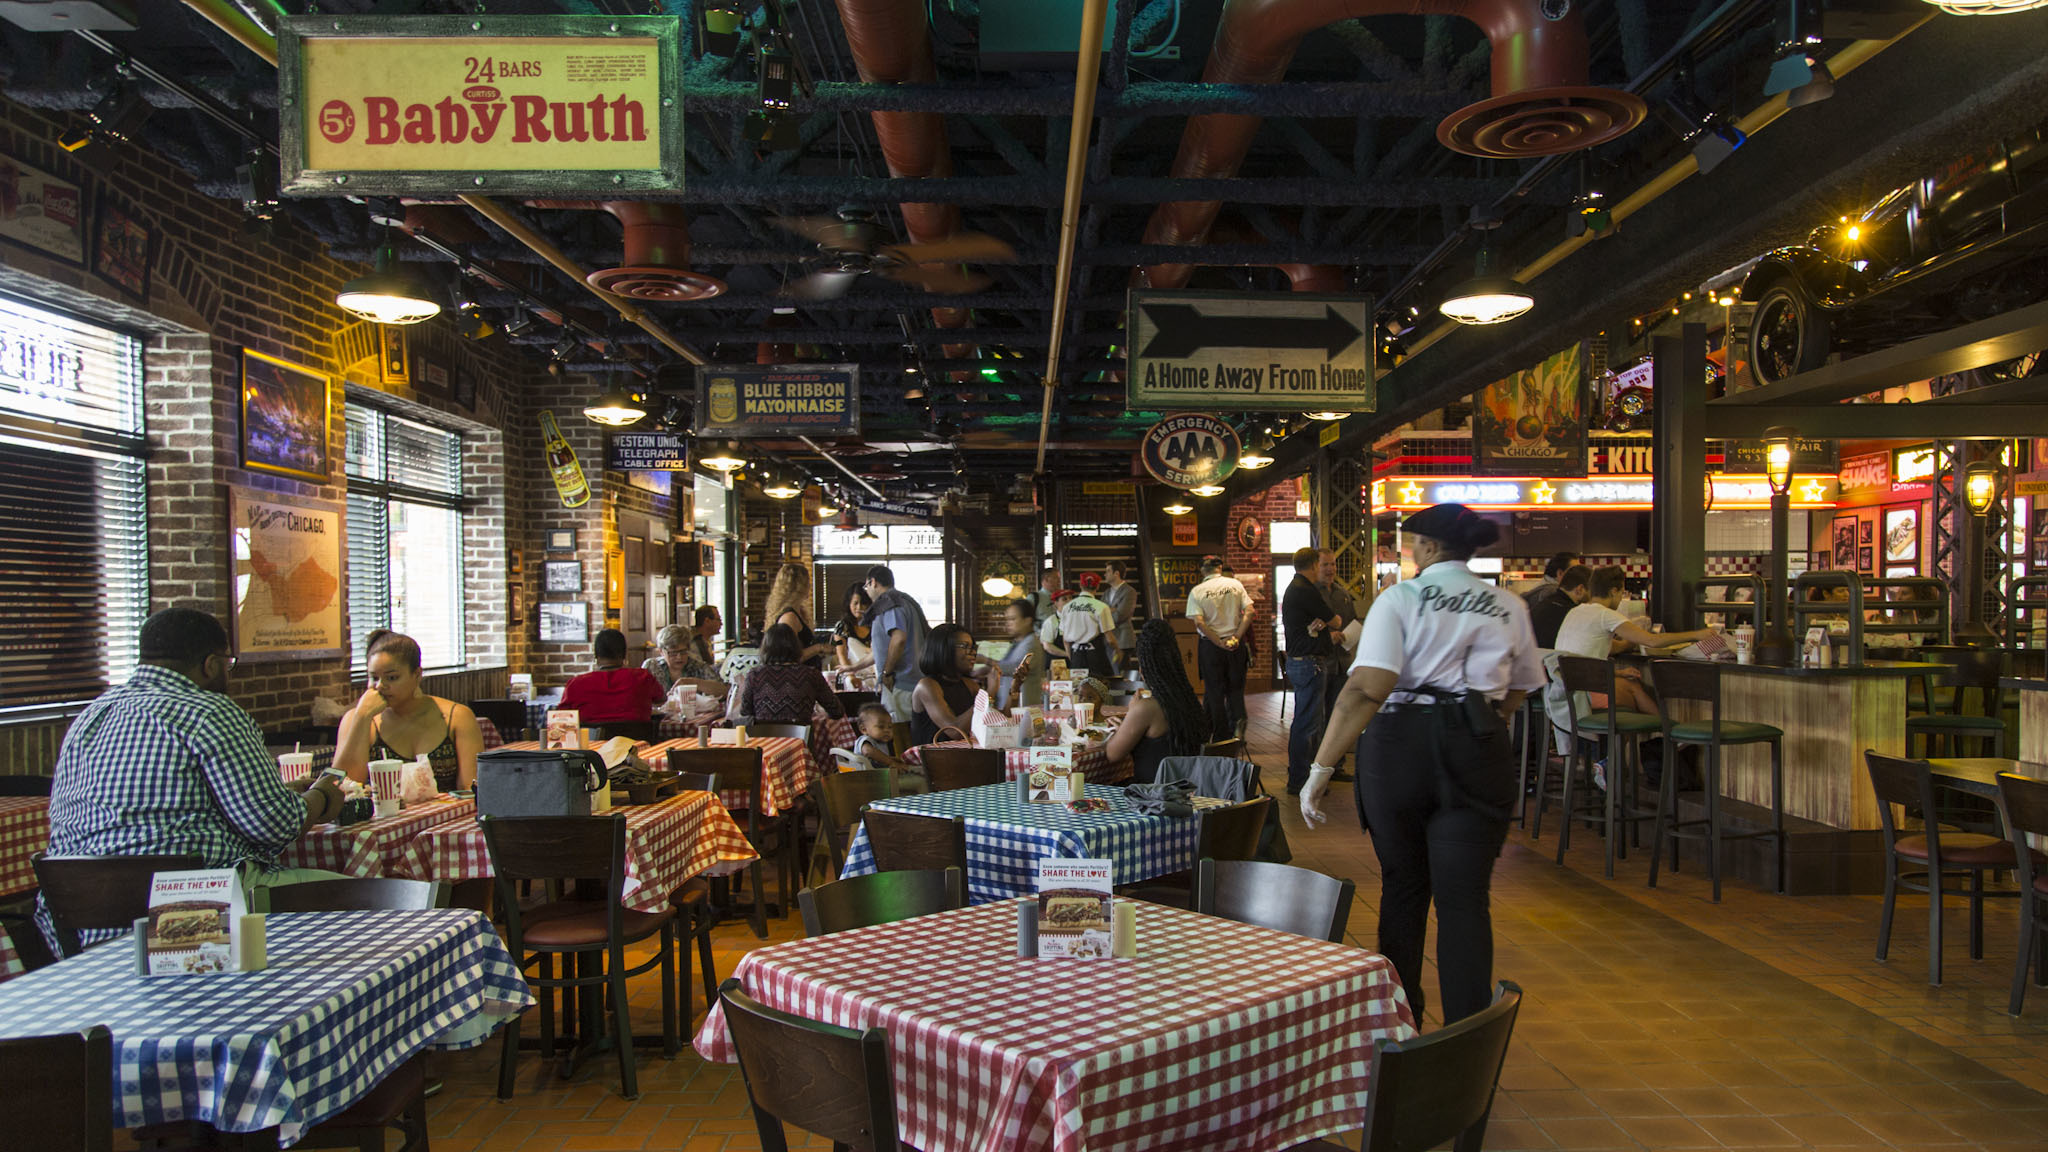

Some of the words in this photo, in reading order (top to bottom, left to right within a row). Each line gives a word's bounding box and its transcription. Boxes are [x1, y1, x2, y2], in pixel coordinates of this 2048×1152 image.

[464, 57, 495, 83] 24
[499, 61, 542, 78] BARS
[466, 89, 497, 99] CURTISS
[363, 95, 508, 145] Baby
[510, 93, 647, 142] Ruth
[1144, 362, 1157, 388] A
[1160, 363, 1209, 389] Home
[1214, 363, 1263, 393] Away
[1269, 364, 1317, 390] From
[1320, 363, 1366, 391] Home
[744, 383, 782, 397] BLUE
[786, 383, 845, 397] RIBBON
[745, 399, 846, 413] MAYONNAISE
[1151, 418, 1230, 443] EMERGENCY
[612, 435, 655, 447] WESTERN
[1794, 443, 1822, 452] FAIR
[618, 448, 679, 458] TELEGRAPH
[1165, 432, 1219, 470] AAA
[1507, 448, 1551, 457] CHICAGO
[624, 459, 653, 467] CABLE
[654, 459, 685, 468] OFFICE
[1839, 463, 1887, 491] SHAKE
[1161, 573, 1201, 584] VICTO
[155, 882, 184, 892] SHARE
[187, 881, 203, 889] THE
